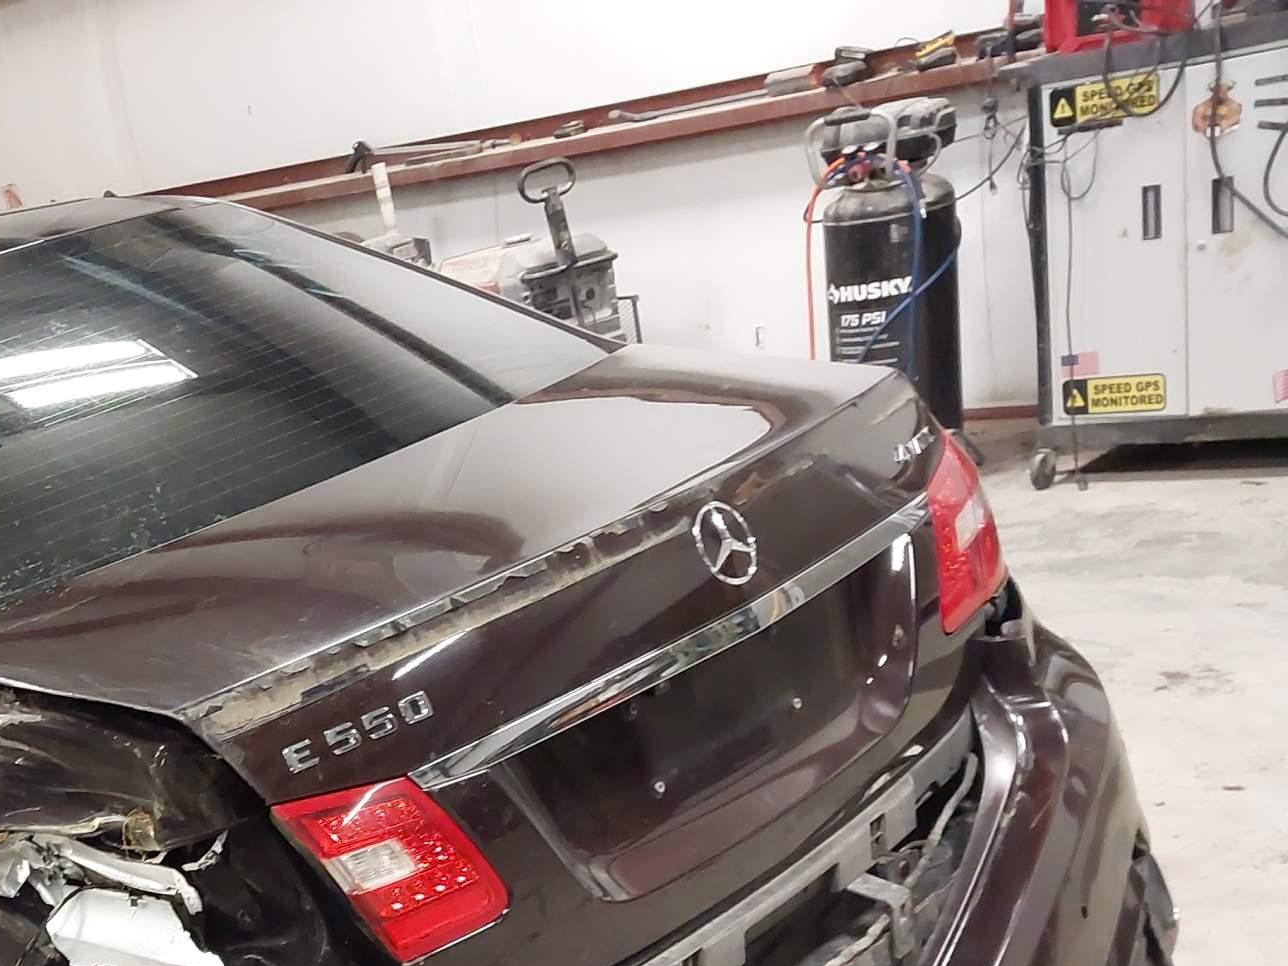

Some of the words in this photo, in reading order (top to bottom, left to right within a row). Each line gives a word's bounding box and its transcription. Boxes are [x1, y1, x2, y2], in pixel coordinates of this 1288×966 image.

[1082, 85, 1123, 102] SPED
[839, 276, 912, 302] HUSKY
[840, 314, 860, 327] 175
[861, 310, 887, 326] PSI
[1093, 382, 1132, 395] SPEED
[1135, 380, 1160, 393] GPS
[1091, 394, 1163, 408] MONITORED
[281, 738, 320, 774] E
[322, 690, 434, 756] 550
